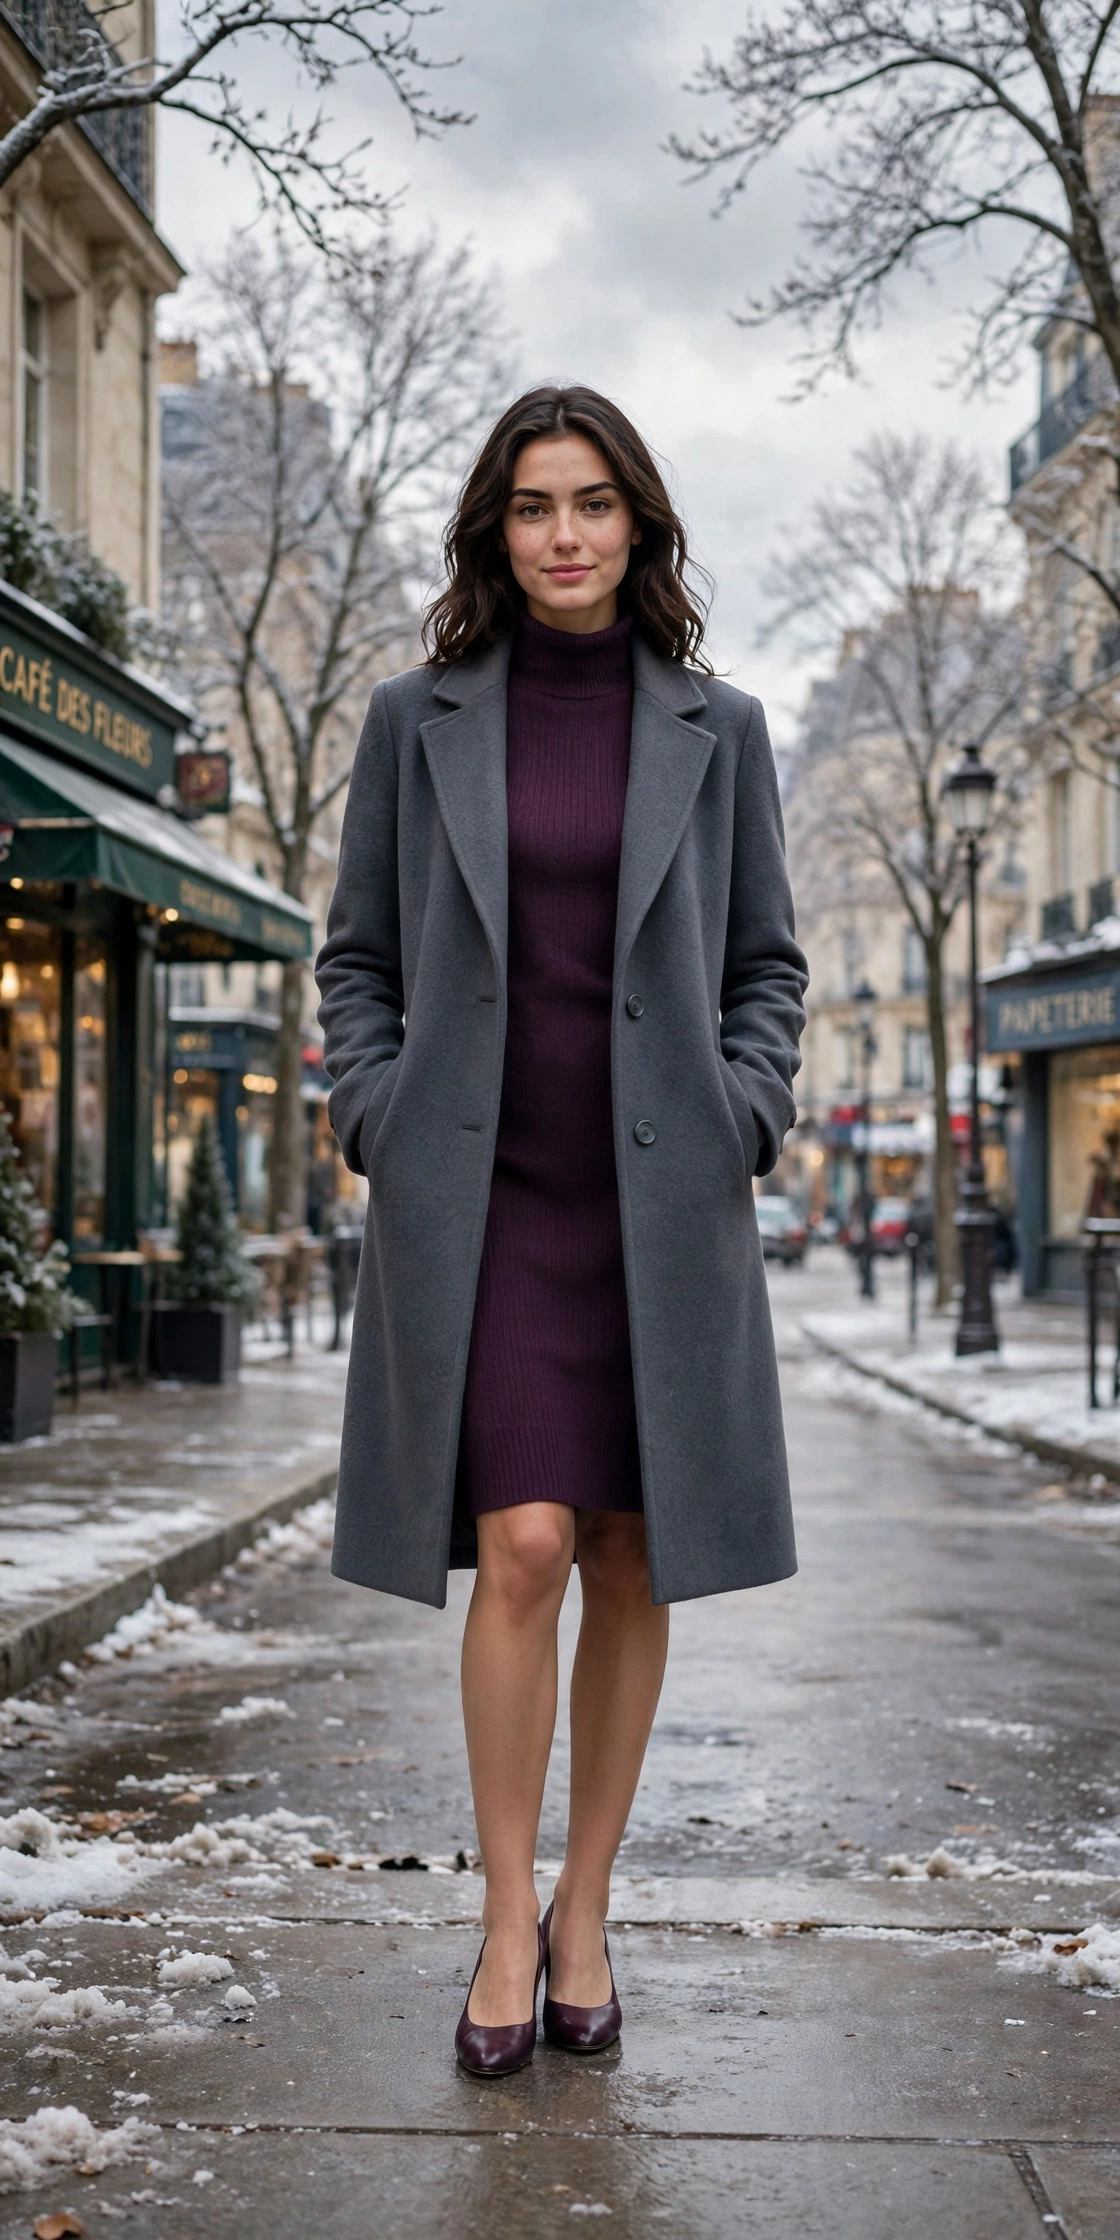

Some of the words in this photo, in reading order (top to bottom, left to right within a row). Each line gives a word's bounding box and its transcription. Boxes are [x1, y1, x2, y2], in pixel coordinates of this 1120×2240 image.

[0, 646, 53, 714] CAFÉ
[57, 678, 91, 734] DES
[93, 700, 152, 768] FLEURS
[999, 986, 1115, 1037] PAPETERIE
